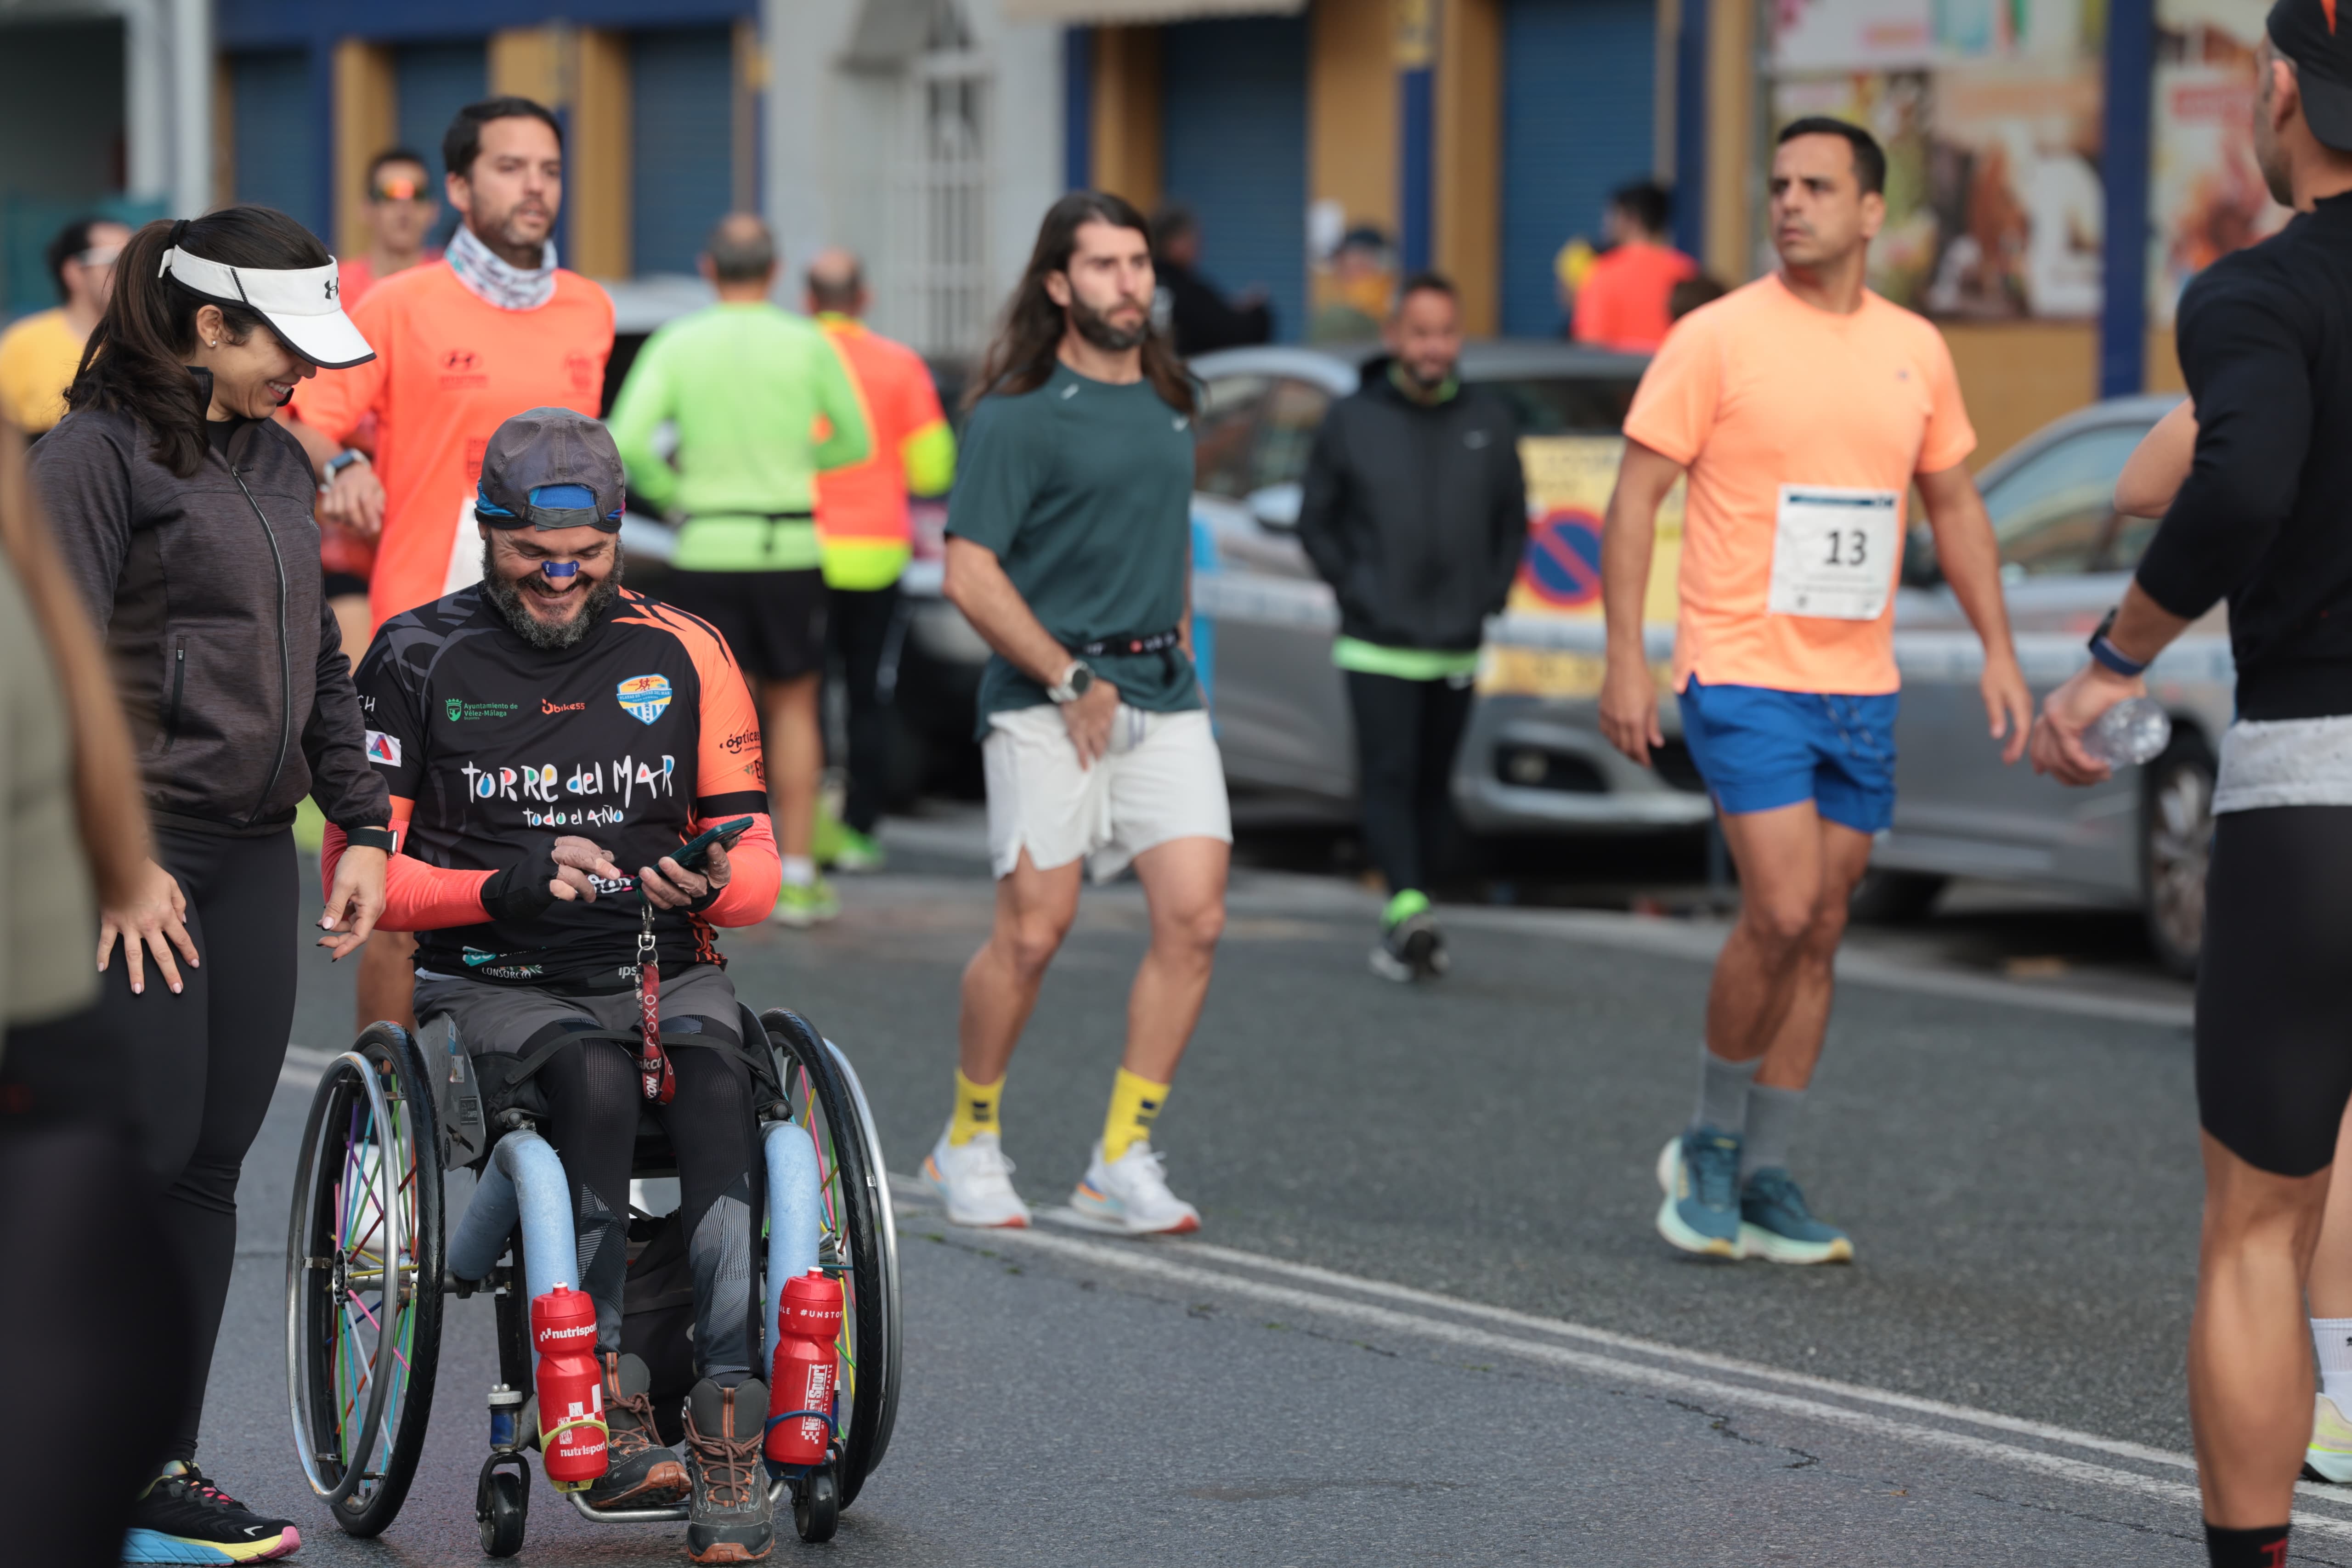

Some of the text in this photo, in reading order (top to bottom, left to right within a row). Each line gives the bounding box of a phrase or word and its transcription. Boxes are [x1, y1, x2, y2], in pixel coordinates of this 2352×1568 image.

[1824, 531, 1867, 566] 13
[726, 730, 760, 748] ópticas
[566, 762, 603, 795] del
[613, 755, 675, 809] MAR
[571, 808, 582, 824] el
[482, 967, 531, 979] CONSORCIO
[560, 1441, 605, 1457] nutrisport
